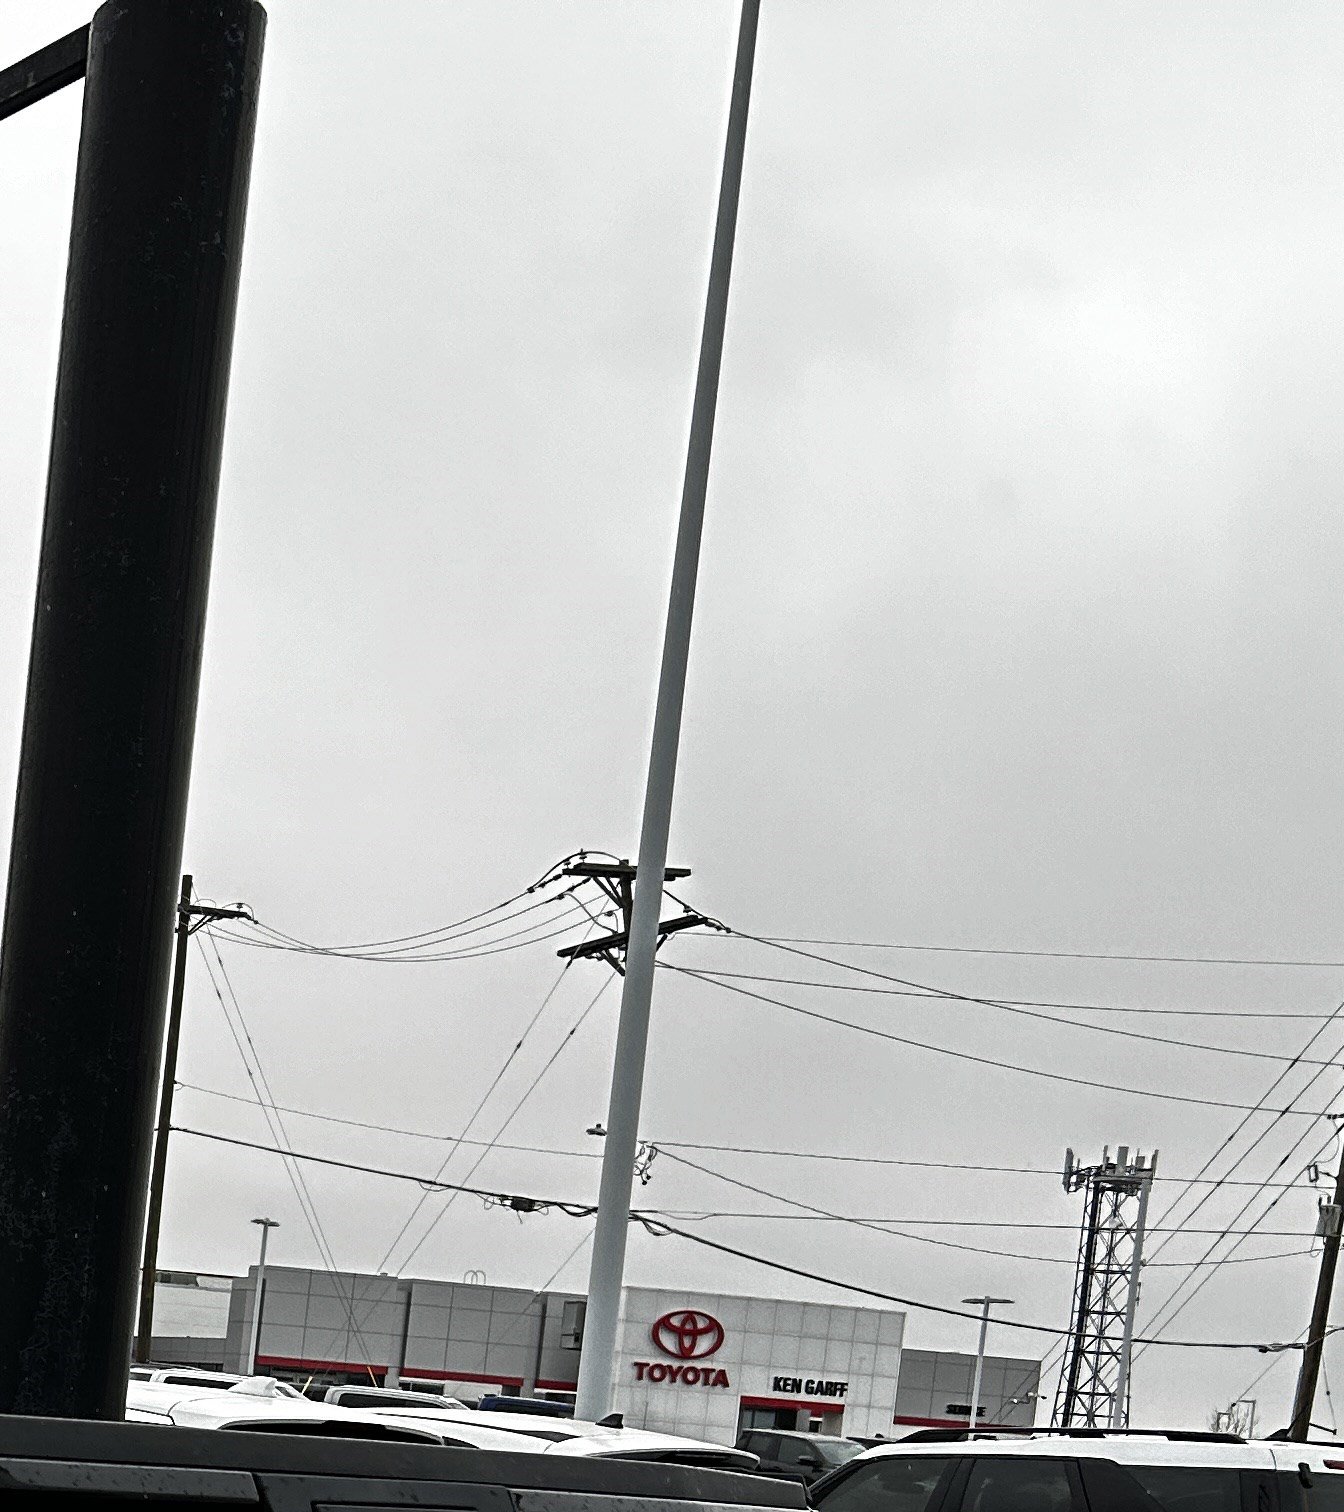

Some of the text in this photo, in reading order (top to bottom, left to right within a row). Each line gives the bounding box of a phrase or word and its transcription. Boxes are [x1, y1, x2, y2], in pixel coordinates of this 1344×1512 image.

[633, 1361, 730, 1389] TOYOTA
[772, 1376, 849, 1398] KEN GARFF
